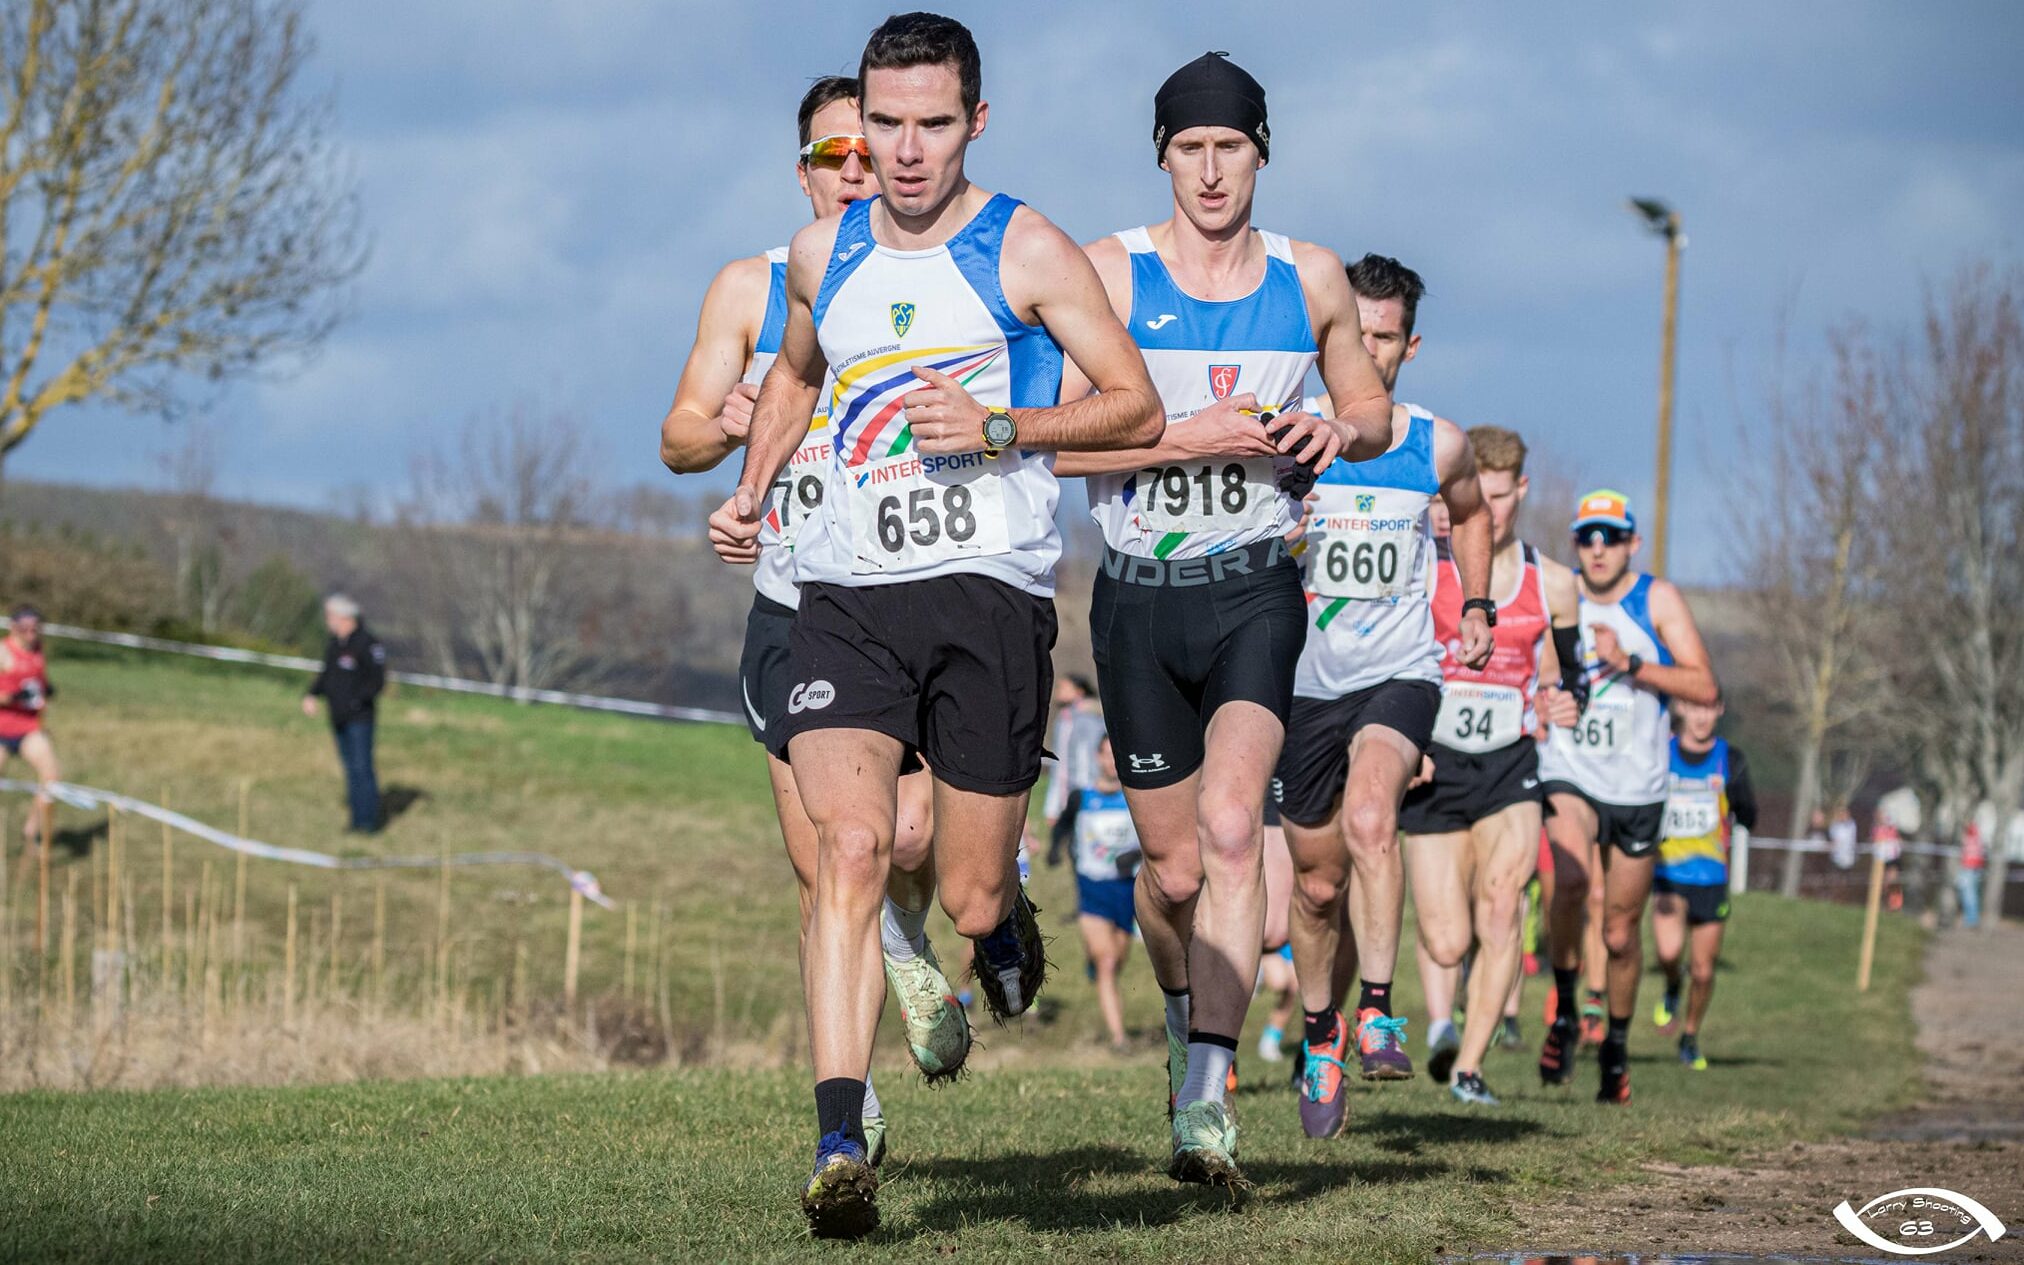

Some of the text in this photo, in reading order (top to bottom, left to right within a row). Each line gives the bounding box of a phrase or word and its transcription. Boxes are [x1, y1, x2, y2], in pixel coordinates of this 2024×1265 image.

[867, 344, 901, 357] AUVERGNE
[871, 451, 984, 485] INTERSPORT
[1140, 462, 1248, 517] 7918
[877, 484, 977, 553] 658
[1327, 518, 1411, 531] INTERSPORT
[1327, 540, 1398, 584] 660
[808, 690, 831, 700] SPORT
[1456, 706, 1493, 741] 34
[1573, 718, 1613, 747] 661
